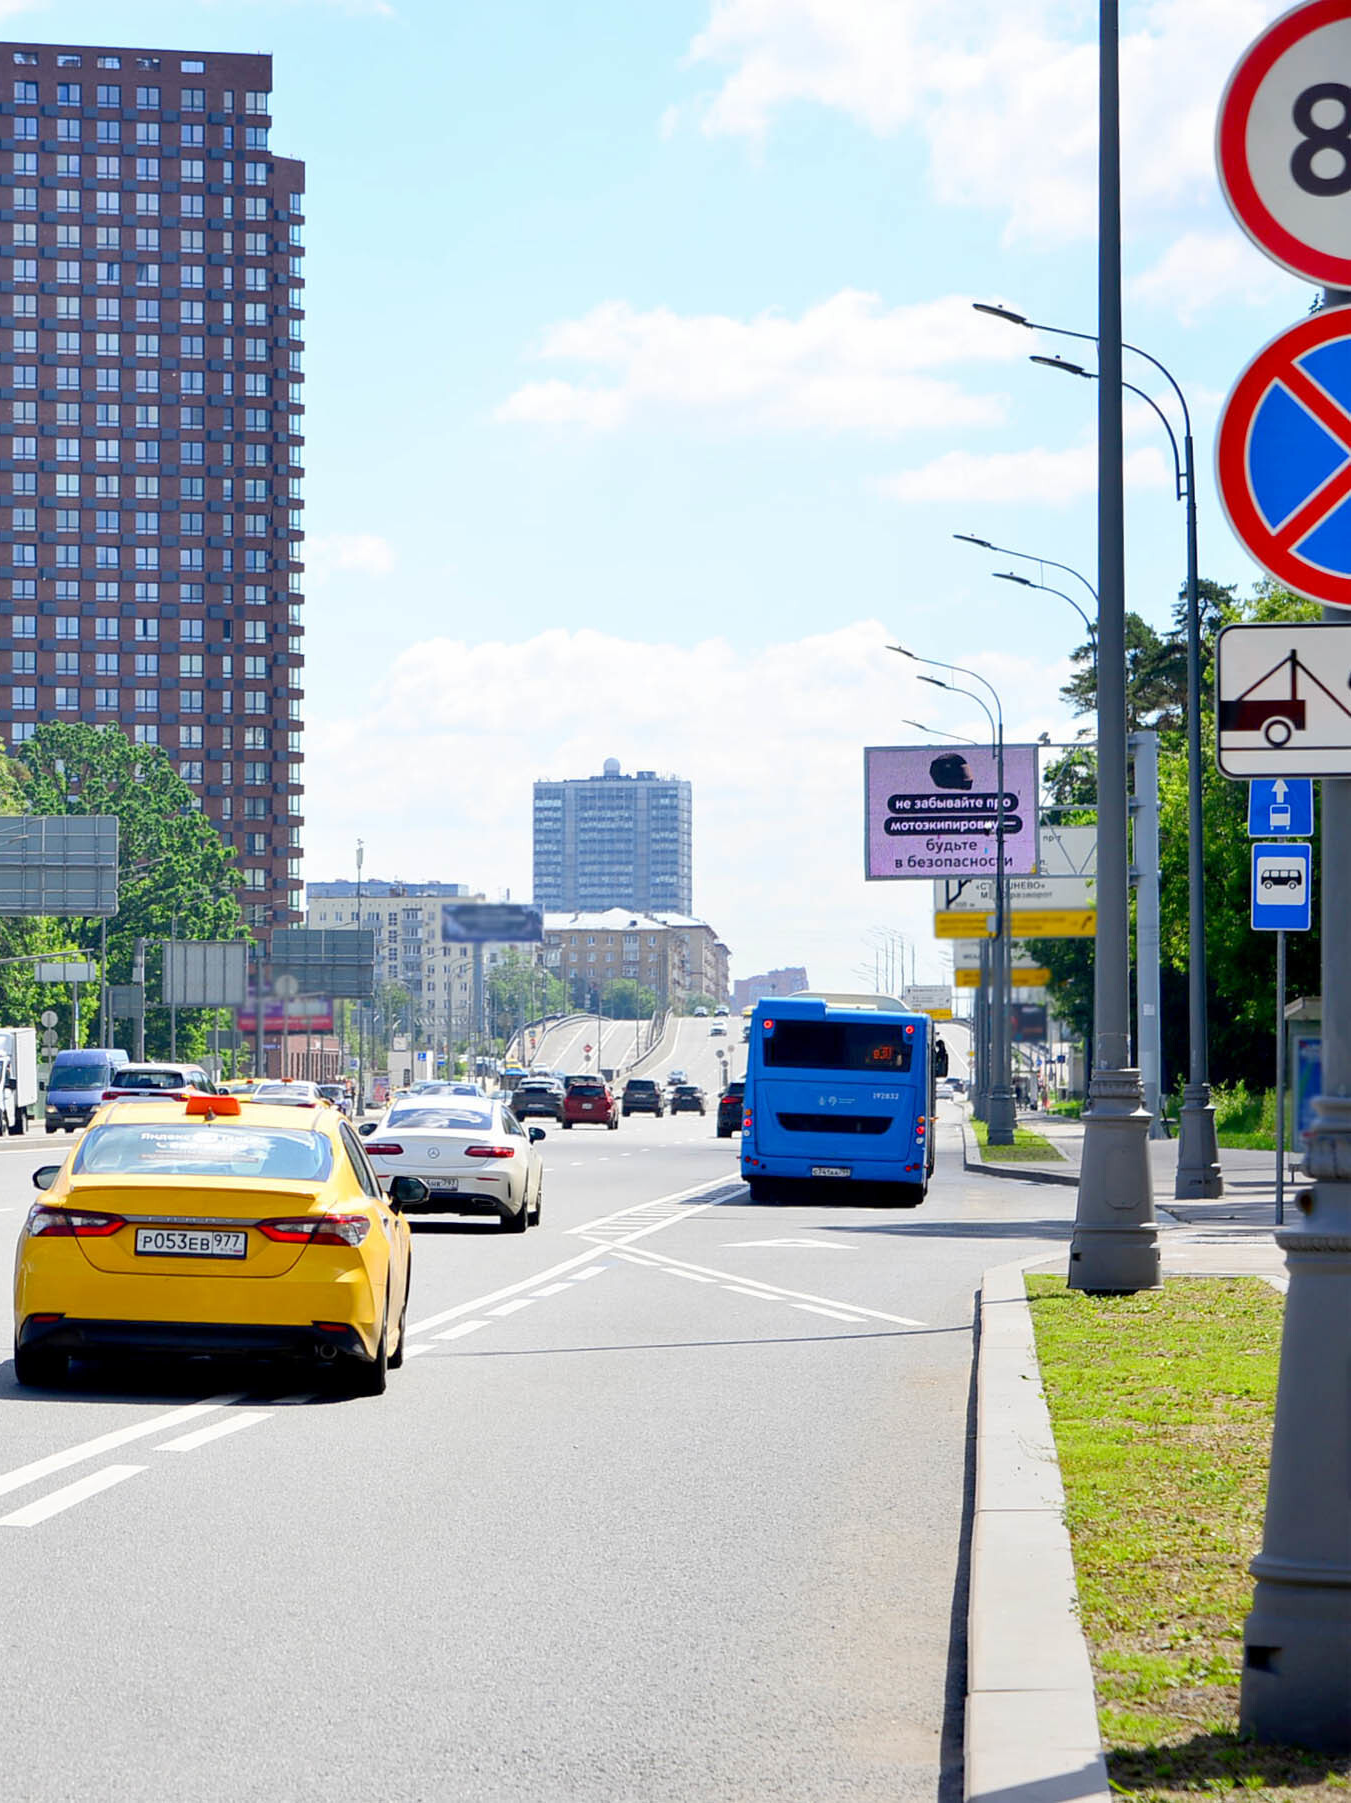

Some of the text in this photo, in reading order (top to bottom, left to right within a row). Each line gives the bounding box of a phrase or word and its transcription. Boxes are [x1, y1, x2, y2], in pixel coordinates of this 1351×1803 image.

[895, 799, 911, 809] не
[914, 797, 984, 809] забывайте
[926, 838, 978, 854] будьте
[895, 855, 1013, 868] в безопасноси
[214, 1233, 240, 1247] 977
